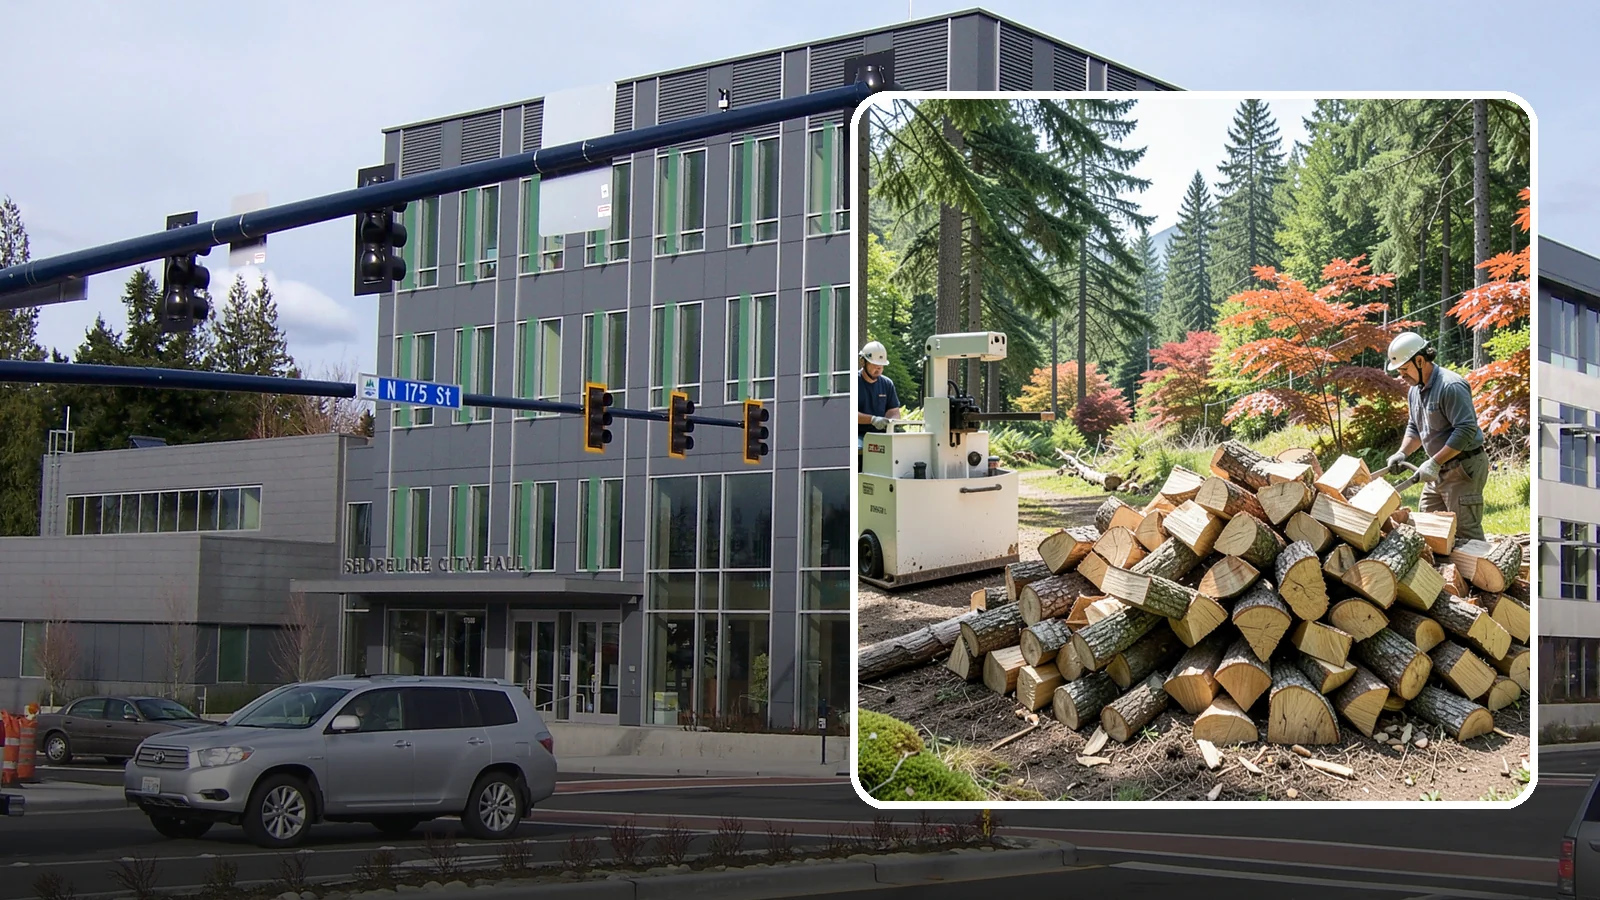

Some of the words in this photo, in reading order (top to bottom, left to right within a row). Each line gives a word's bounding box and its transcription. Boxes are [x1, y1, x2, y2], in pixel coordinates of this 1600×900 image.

[387, 380, 397, 400] N
[405, 382, 428, 403] 175
[436, 386, 452, 406] St
[344, 556, 432, 574] SHORELINE
[438, 556, 475, 573] CITY
[483, 555, 526, 572] HALL
